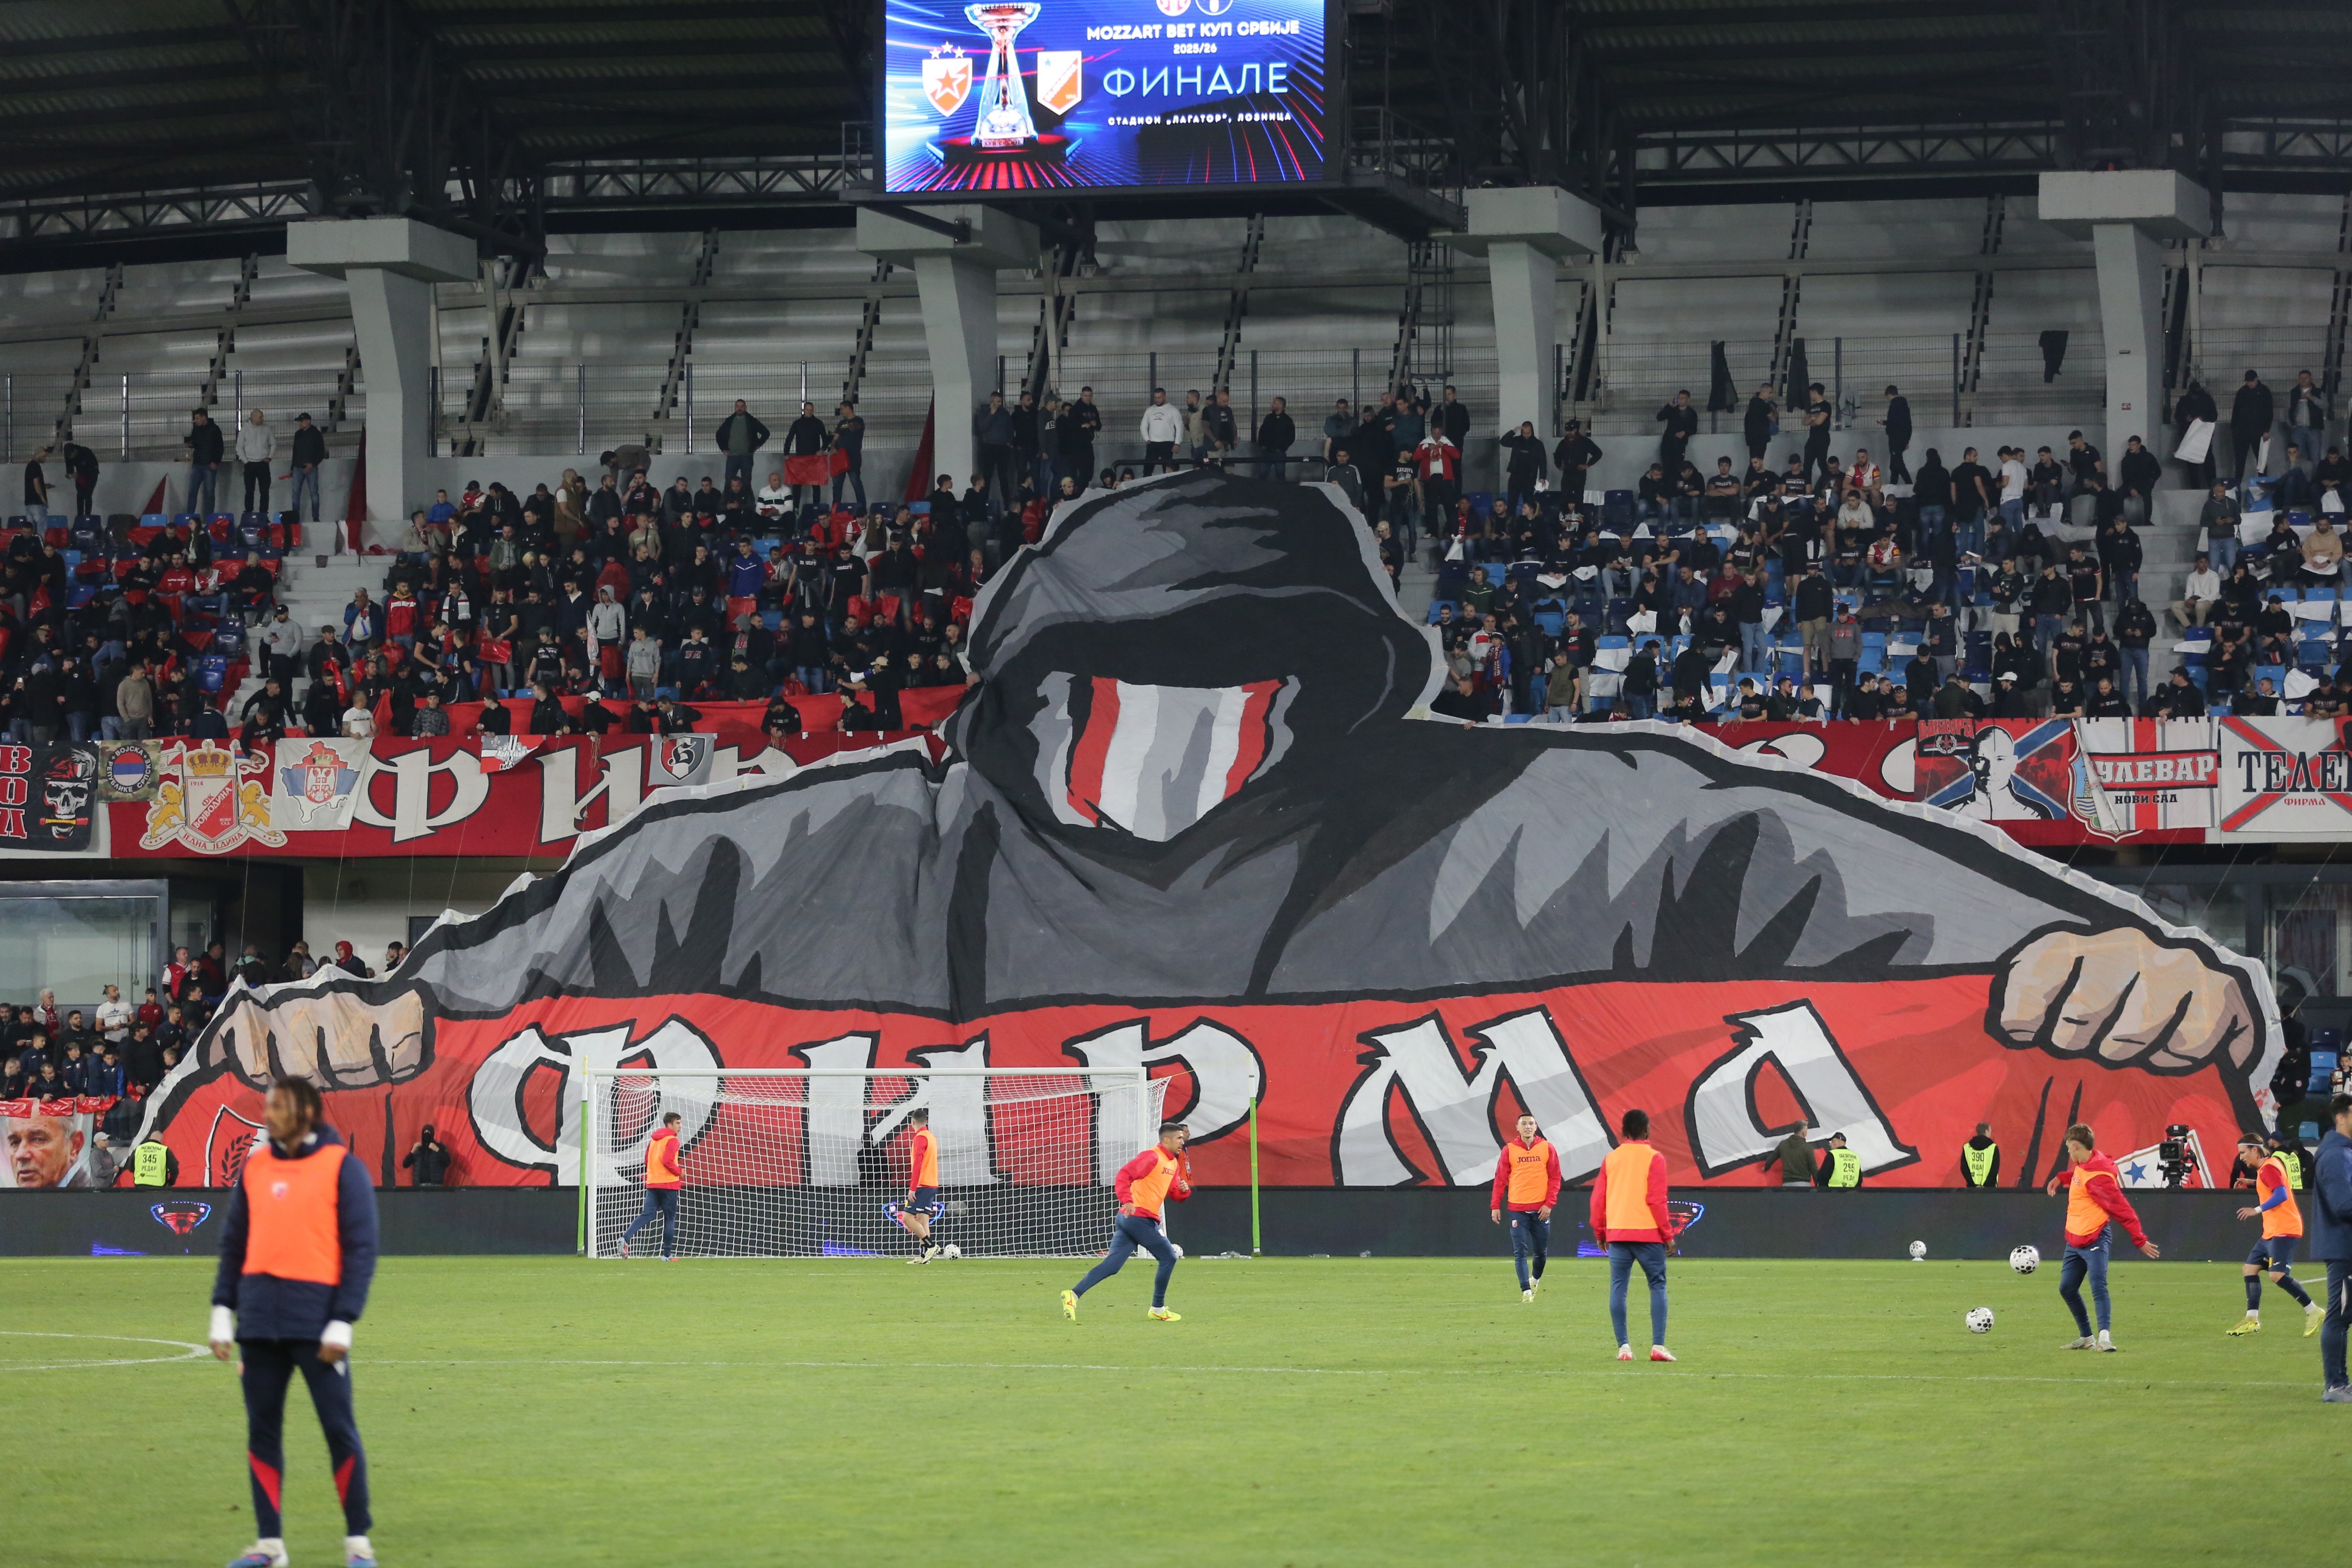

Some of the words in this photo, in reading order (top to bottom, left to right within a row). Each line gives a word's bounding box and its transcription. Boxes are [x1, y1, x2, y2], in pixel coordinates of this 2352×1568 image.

[1087, 24, 1162, 41] MOZZART
[1200, 22, 1233, 38] КУП
[1236, 20, 1300, 36] СРБИЈЕ
[1173, 43, 1217, 54] 2025/26
[1102, 62, 1288, 98] ФИНАЛЕ
[1107, 116, 1161, 126] СТАДИОН
[1237, 112, 1291, 122] ЛОЗНИЦА
[114, 746, 144, 757] ВОЈСКА
[107, 761, 133, 792] РЕПУБЛИКЕ
[137, 758, 151, 788] СРПСКЕ
[2095, 754, 2216, 783] УЛЕВАР
[202, 794, 214, 806] ФК
[2115, 795, 2148, 804] НОВИ
[2152, 794, 2177, 803] САД
[193, 787, 232, 829] ВОЈВОДИНА
[183, 833, 207, 849] ЈЕДНА
[213, 832, 243, 850] ЈЕДИНА
[468, 998, 1921, 1188] ФИРМА
[143, 1154, 157, 1163] 345
[1971, 1152, 1984, 1161] 390
